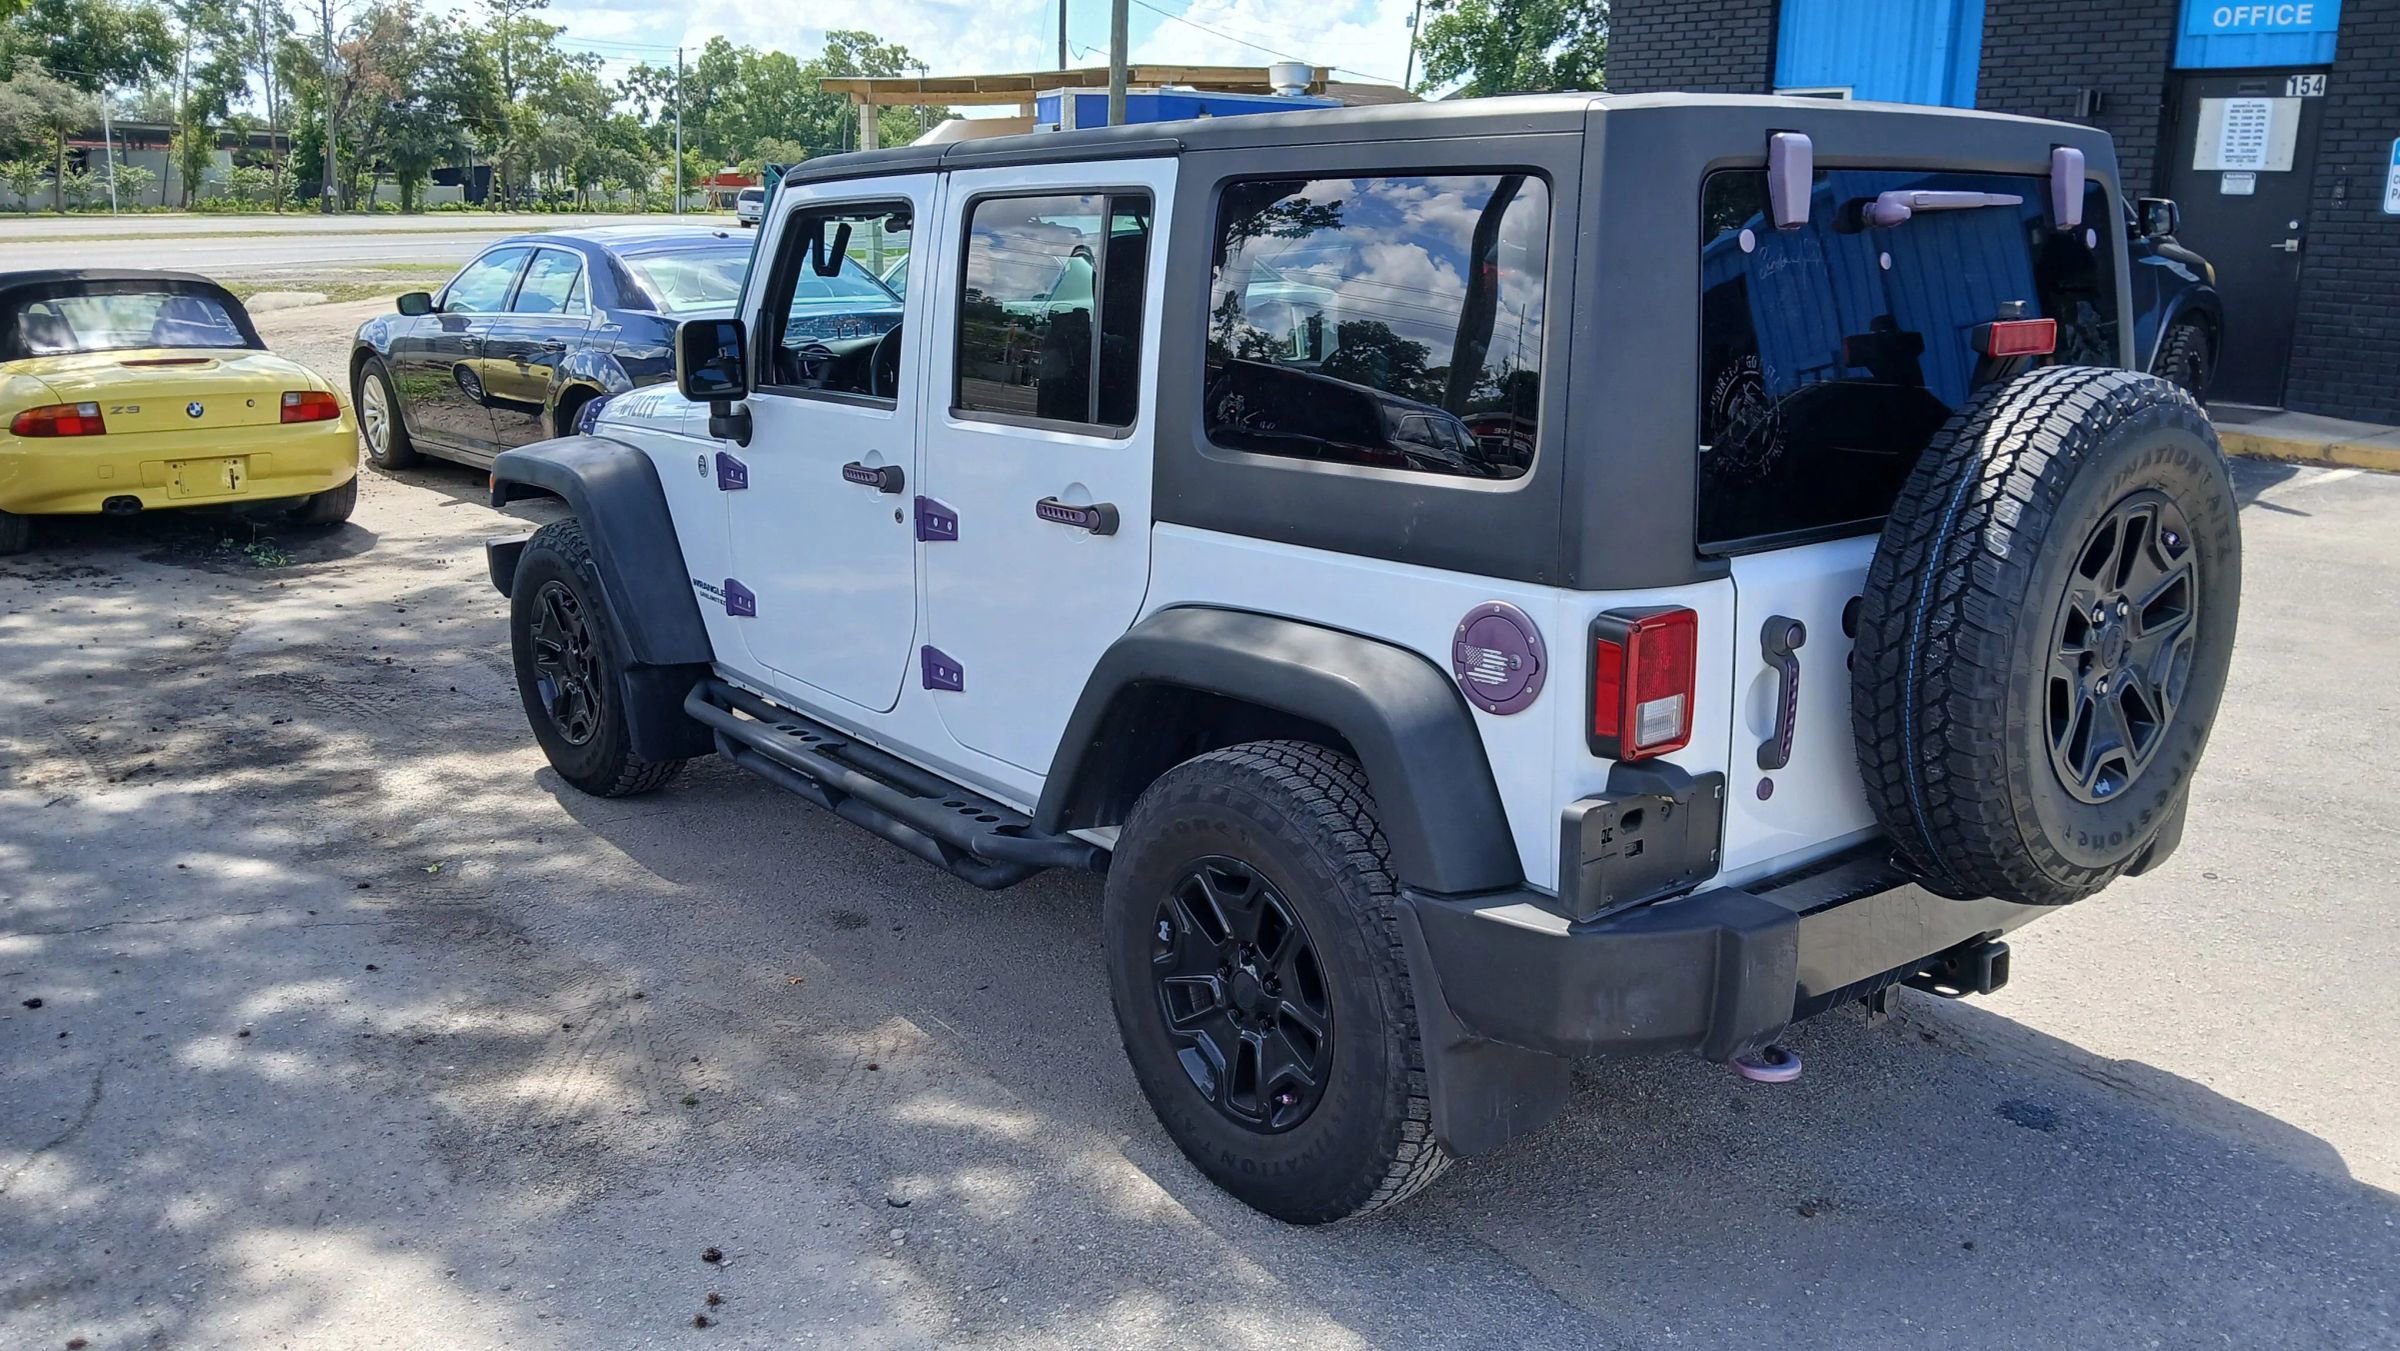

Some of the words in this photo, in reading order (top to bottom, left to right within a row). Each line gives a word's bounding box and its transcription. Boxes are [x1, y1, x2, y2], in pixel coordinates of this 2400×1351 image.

[2213, 4, 2314, 27] OFFICE
[2290, 76, 2323, 96] 154
[110, 405, 140, 415] Z3
[692, 578, 726, 598] WRANGLE
